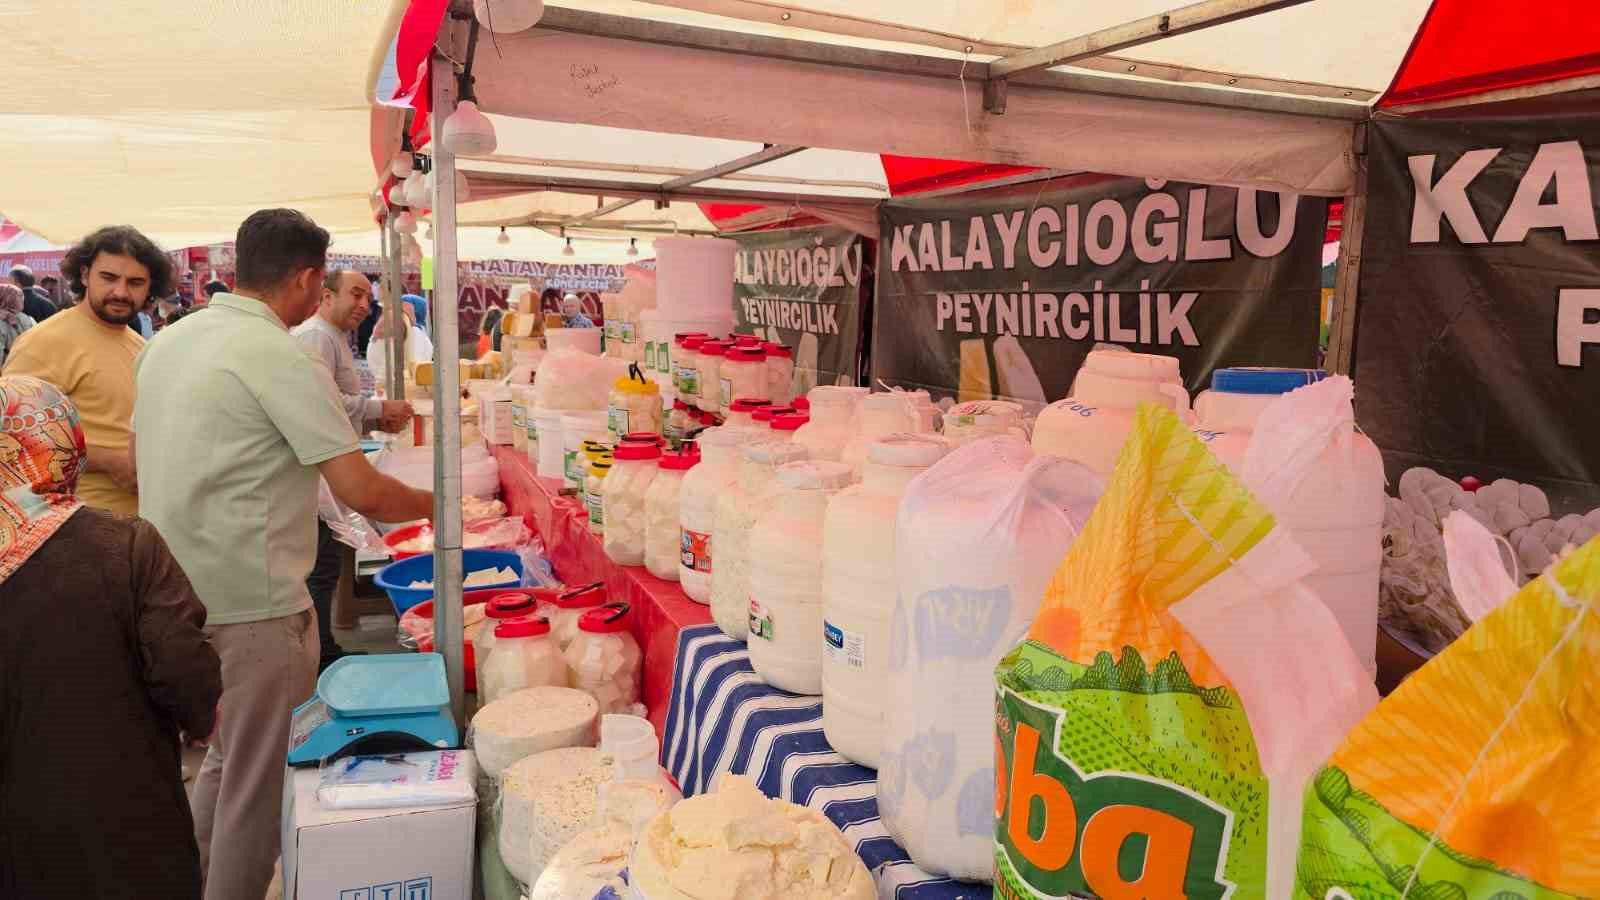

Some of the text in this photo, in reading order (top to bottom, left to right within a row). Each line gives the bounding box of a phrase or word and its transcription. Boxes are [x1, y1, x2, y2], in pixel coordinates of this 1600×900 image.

[890, 175, 1299, 272] KALAYCIOĞLU
[470, 259, 547, 277] HATAY
[734, 237, 863, 289] ALAYCIOĞLU
[741, 294, 840, 336] PEYNİRCİLİK
[936, 278, 1202, 346] PEYNİRCİLİK
[994, 720, 1196, 900] ba
